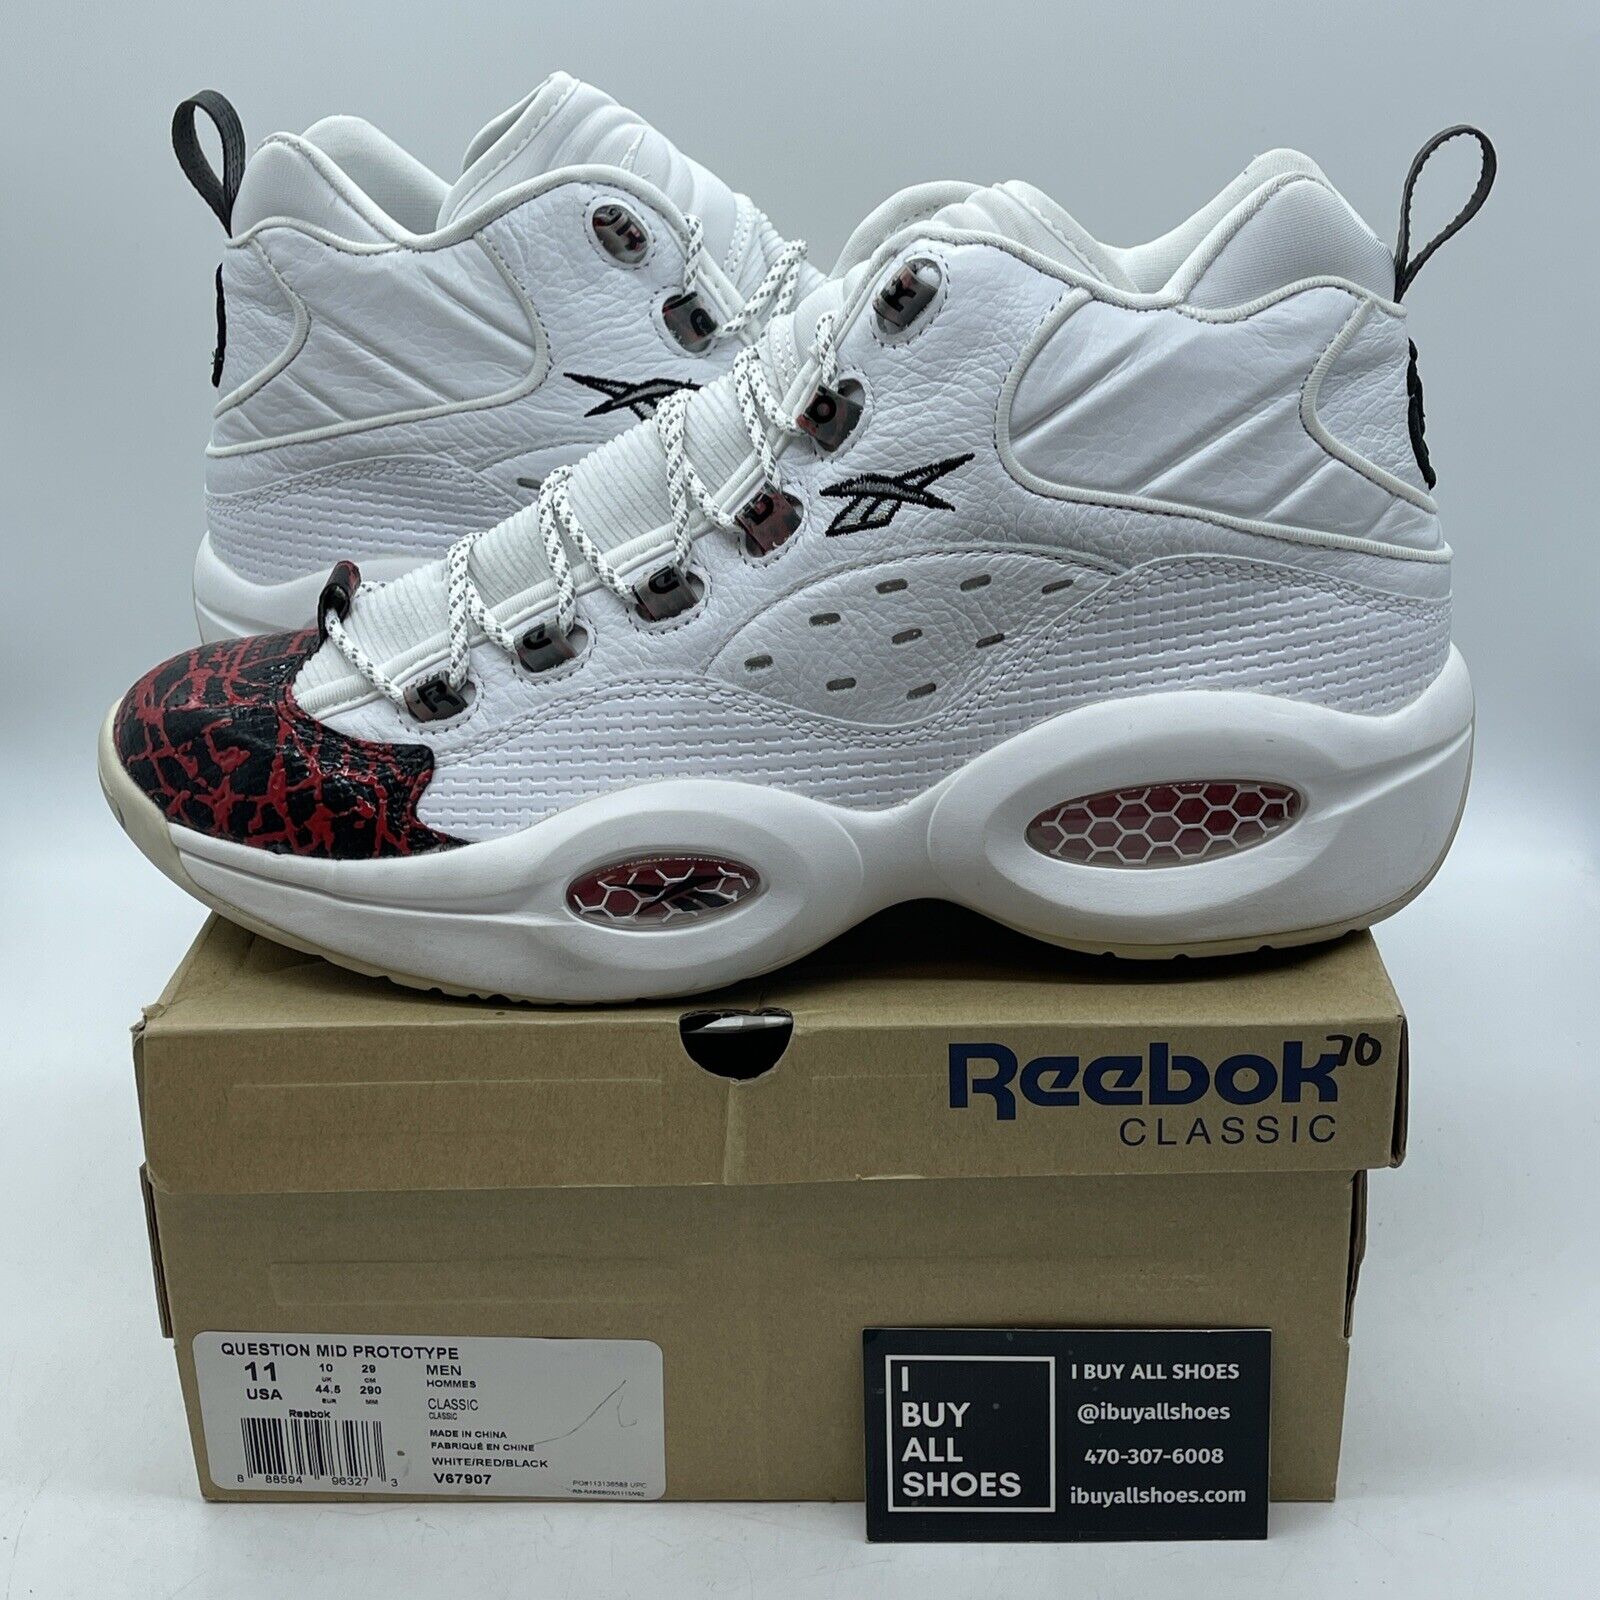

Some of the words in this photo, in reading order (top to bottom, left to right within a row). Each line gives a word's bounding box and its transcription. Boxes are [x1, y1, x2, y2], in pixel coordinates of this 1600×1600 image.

[948, 1041, 1339, 1120] Reebok
[1119, 1114, 1336, 1147] CLASSIC
[221, 1342, 310, 1357] QUESTION
[316, 1344, 347, 1358] MID
[353, 1345, 459, 1360] PROTOTYPE
[244, 1361, 277, 1382] 11
[319, 1363, 333, 1373] 10
[361, 1364, 376, 1374] 29
[426, 1364, 462, 1376] MEN
[901, 1365, 909, 1392] I
[1071, 1363, 1077, 1380] I
[1084, 1363, 1124, 1380] BUY
[1131, 1363, 1167, 1380] ALL
[1172, 1363, 1240, 1380] SHOES
[246, 1388, 283, 1400] USA
[315, 1385, 341, 1394] 44.5
[360, 1385, 382, 1395] 290
[426, 1380, 477, 1388] HOMMES
[427, 1397, 479, 1411] CLASSIC
[289, 1409, 331, 1418] Reebok
[428, 1412, 458, 1420] CLASSIC
[901, 1401, 971, 1428] BUY
[1076, 1401, 1231, 1425] @ibuyallshoes
[430, 1429, 459, 1438] MADE
[461, 1430, 472, 1438] IN
[474, 1430, 507, 1439] CHINA
[431, 1441, 484, 1451] FABRIQUÉ
[486, 1443, 500, 1451] EN
[503, 1444, 535, 1452] CHINE
[901, 1436, 963, 1463] ALL
[432, 1457, 548, 1468] WHITE/RED/BLACK
[1084, 1448, 1224, 1465] 470-307-6008
[237, 1474, 245, 1483] 8
[265, 1475, 303, 1484] 88594
[391, 1478, 398, 1487] 3
[433, 1473, 492, 1485] V67907
[902, 1471, 1022, 1498] SHOES
[1070, 1486, 1247, 1508] ibuyallshoes.com
